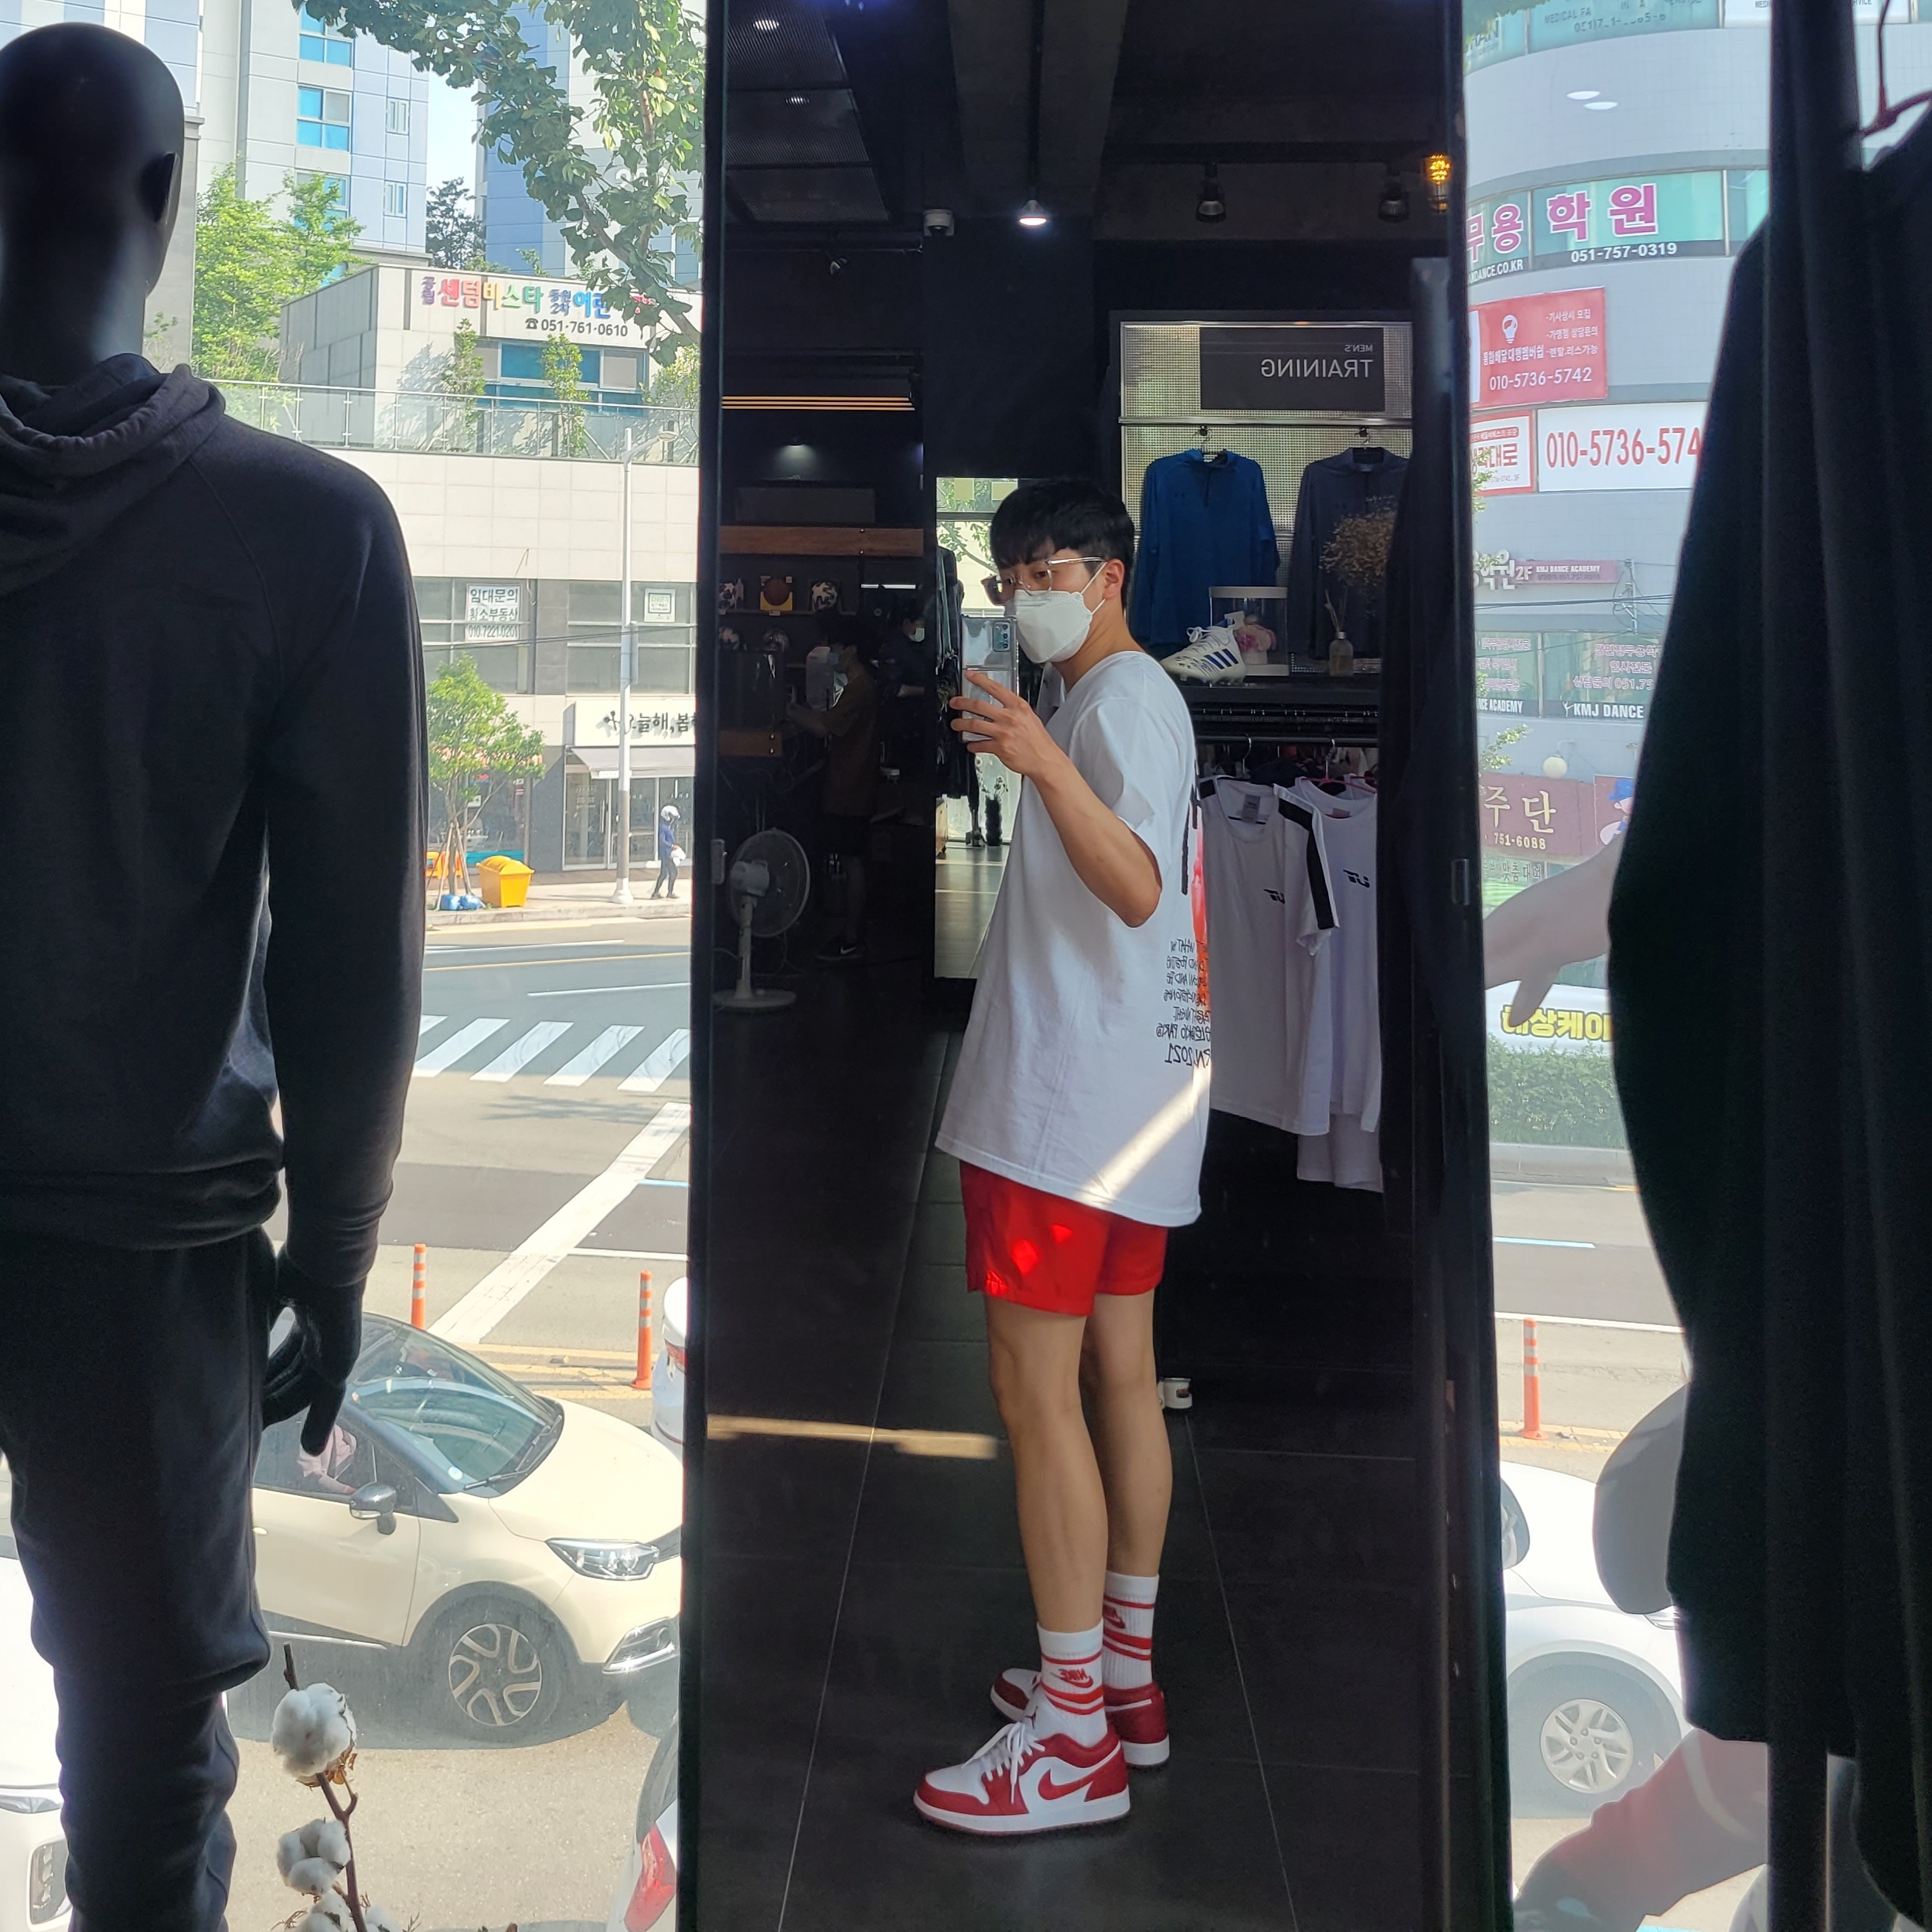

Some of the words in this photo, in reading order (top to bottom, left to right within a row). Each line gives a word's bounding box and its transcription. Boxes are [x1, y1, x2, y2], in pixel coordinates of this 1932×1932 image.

[1544, 12, 1577, 25] MEDICAL
[1571, 242, 1678, 263] 051-757-0319
[438, 278, 543, 312] 센텀비스타
[1489, 366, 1593, 391] 010-5736-5742
[1515, 566, 1533, 581] 2F
[469, 588, 519, 603] 임대문의
[1489, 699, 1524, 714] ACADEMY
[1573, 703, 1600, 717] KMJ
[1603, 704, 1644, 719] DANCE
